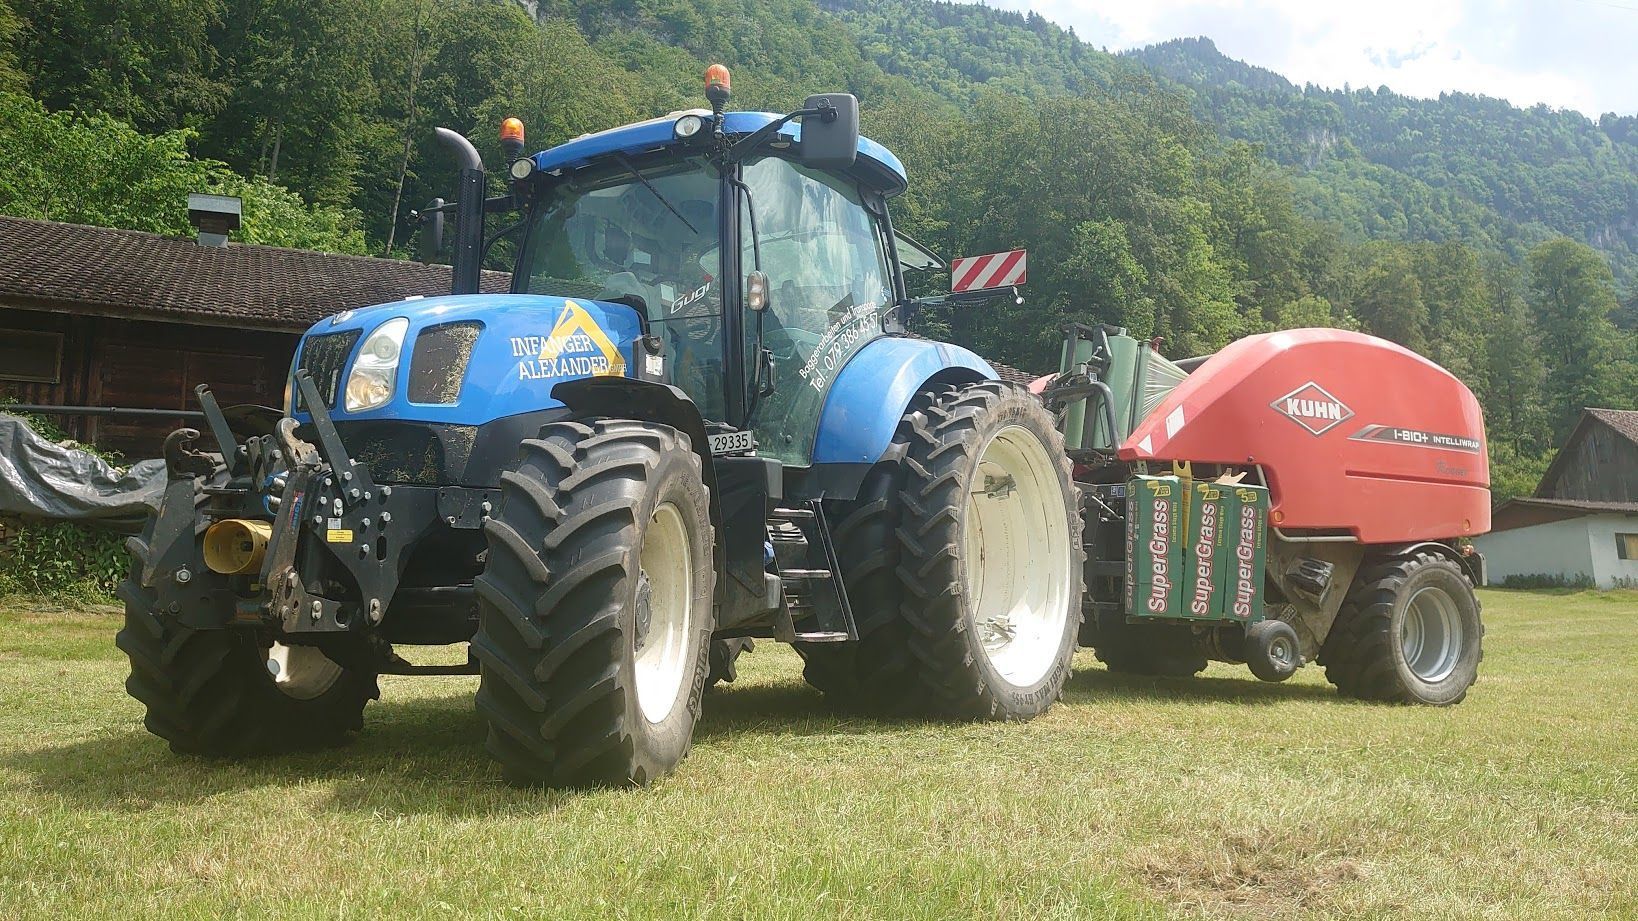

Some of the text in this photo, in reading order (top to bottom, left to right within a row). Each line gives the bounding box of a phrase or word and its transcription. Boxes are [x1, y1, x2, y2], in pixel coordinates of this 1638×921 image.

[671, 282, 710, 314] Gugi
[510, 334, 595, 357] INFANGER
[799, 322, 841, 379] Baggerarbeiten
[841, 306, 852, 325] und
[518, 356, 609, 380] ALEXANDER
[810, 368, 829, 393] Tel.
[842, 325, 859, 349] 386
[1286, 398, 1341, 420] KUHN
[714, 433, 749, 451] 29335
[1393, 429, 1480, 449] I-BIO+ INTELLIWRAP
[1149, 499, 1172, 612] SuperGrass
[1192, 502, 1217, 615] SuperGrass
[1234, 505, 1255, 617] SuperGrass
